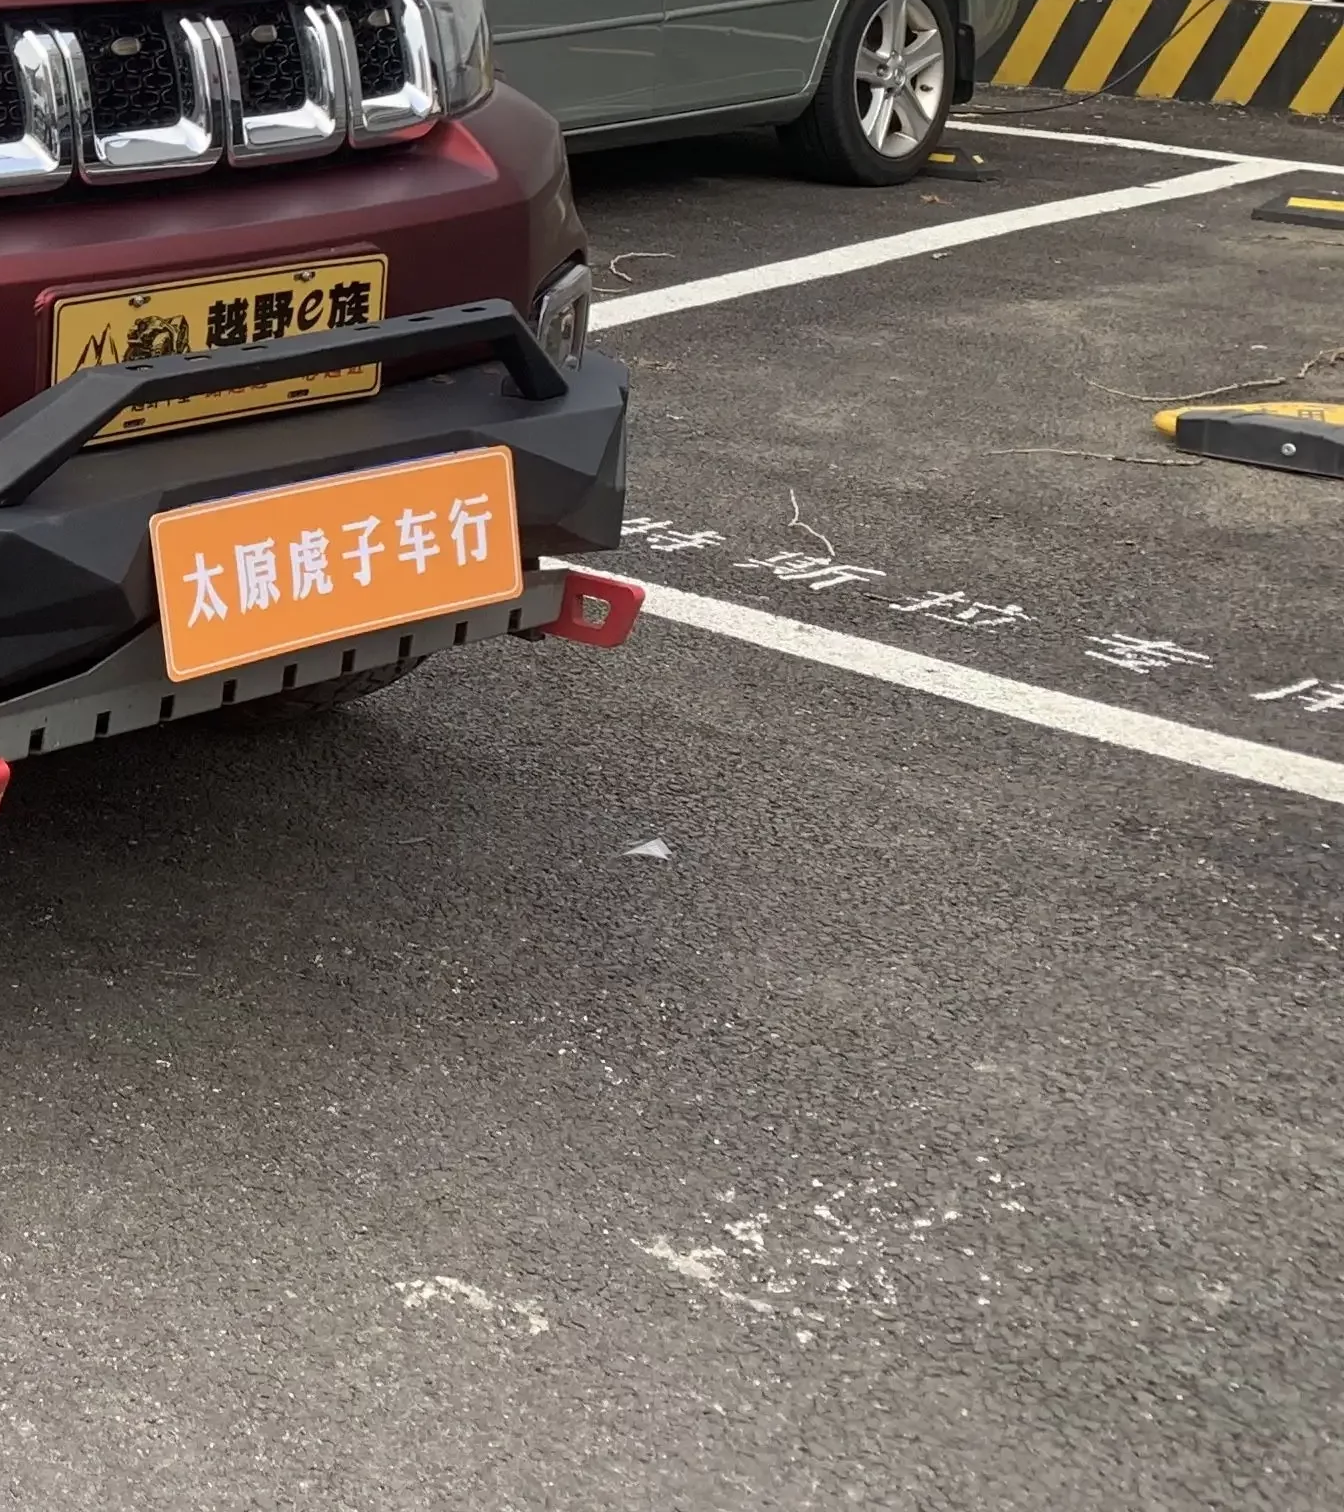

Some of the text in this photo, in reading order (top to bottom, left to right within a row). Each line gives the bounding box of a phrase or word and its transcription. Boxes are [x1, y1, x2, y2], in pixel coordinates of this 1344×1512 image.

[206, 281, 372, 349] 越野e族
[182, 493, 494, 629] 太原虎子车行
